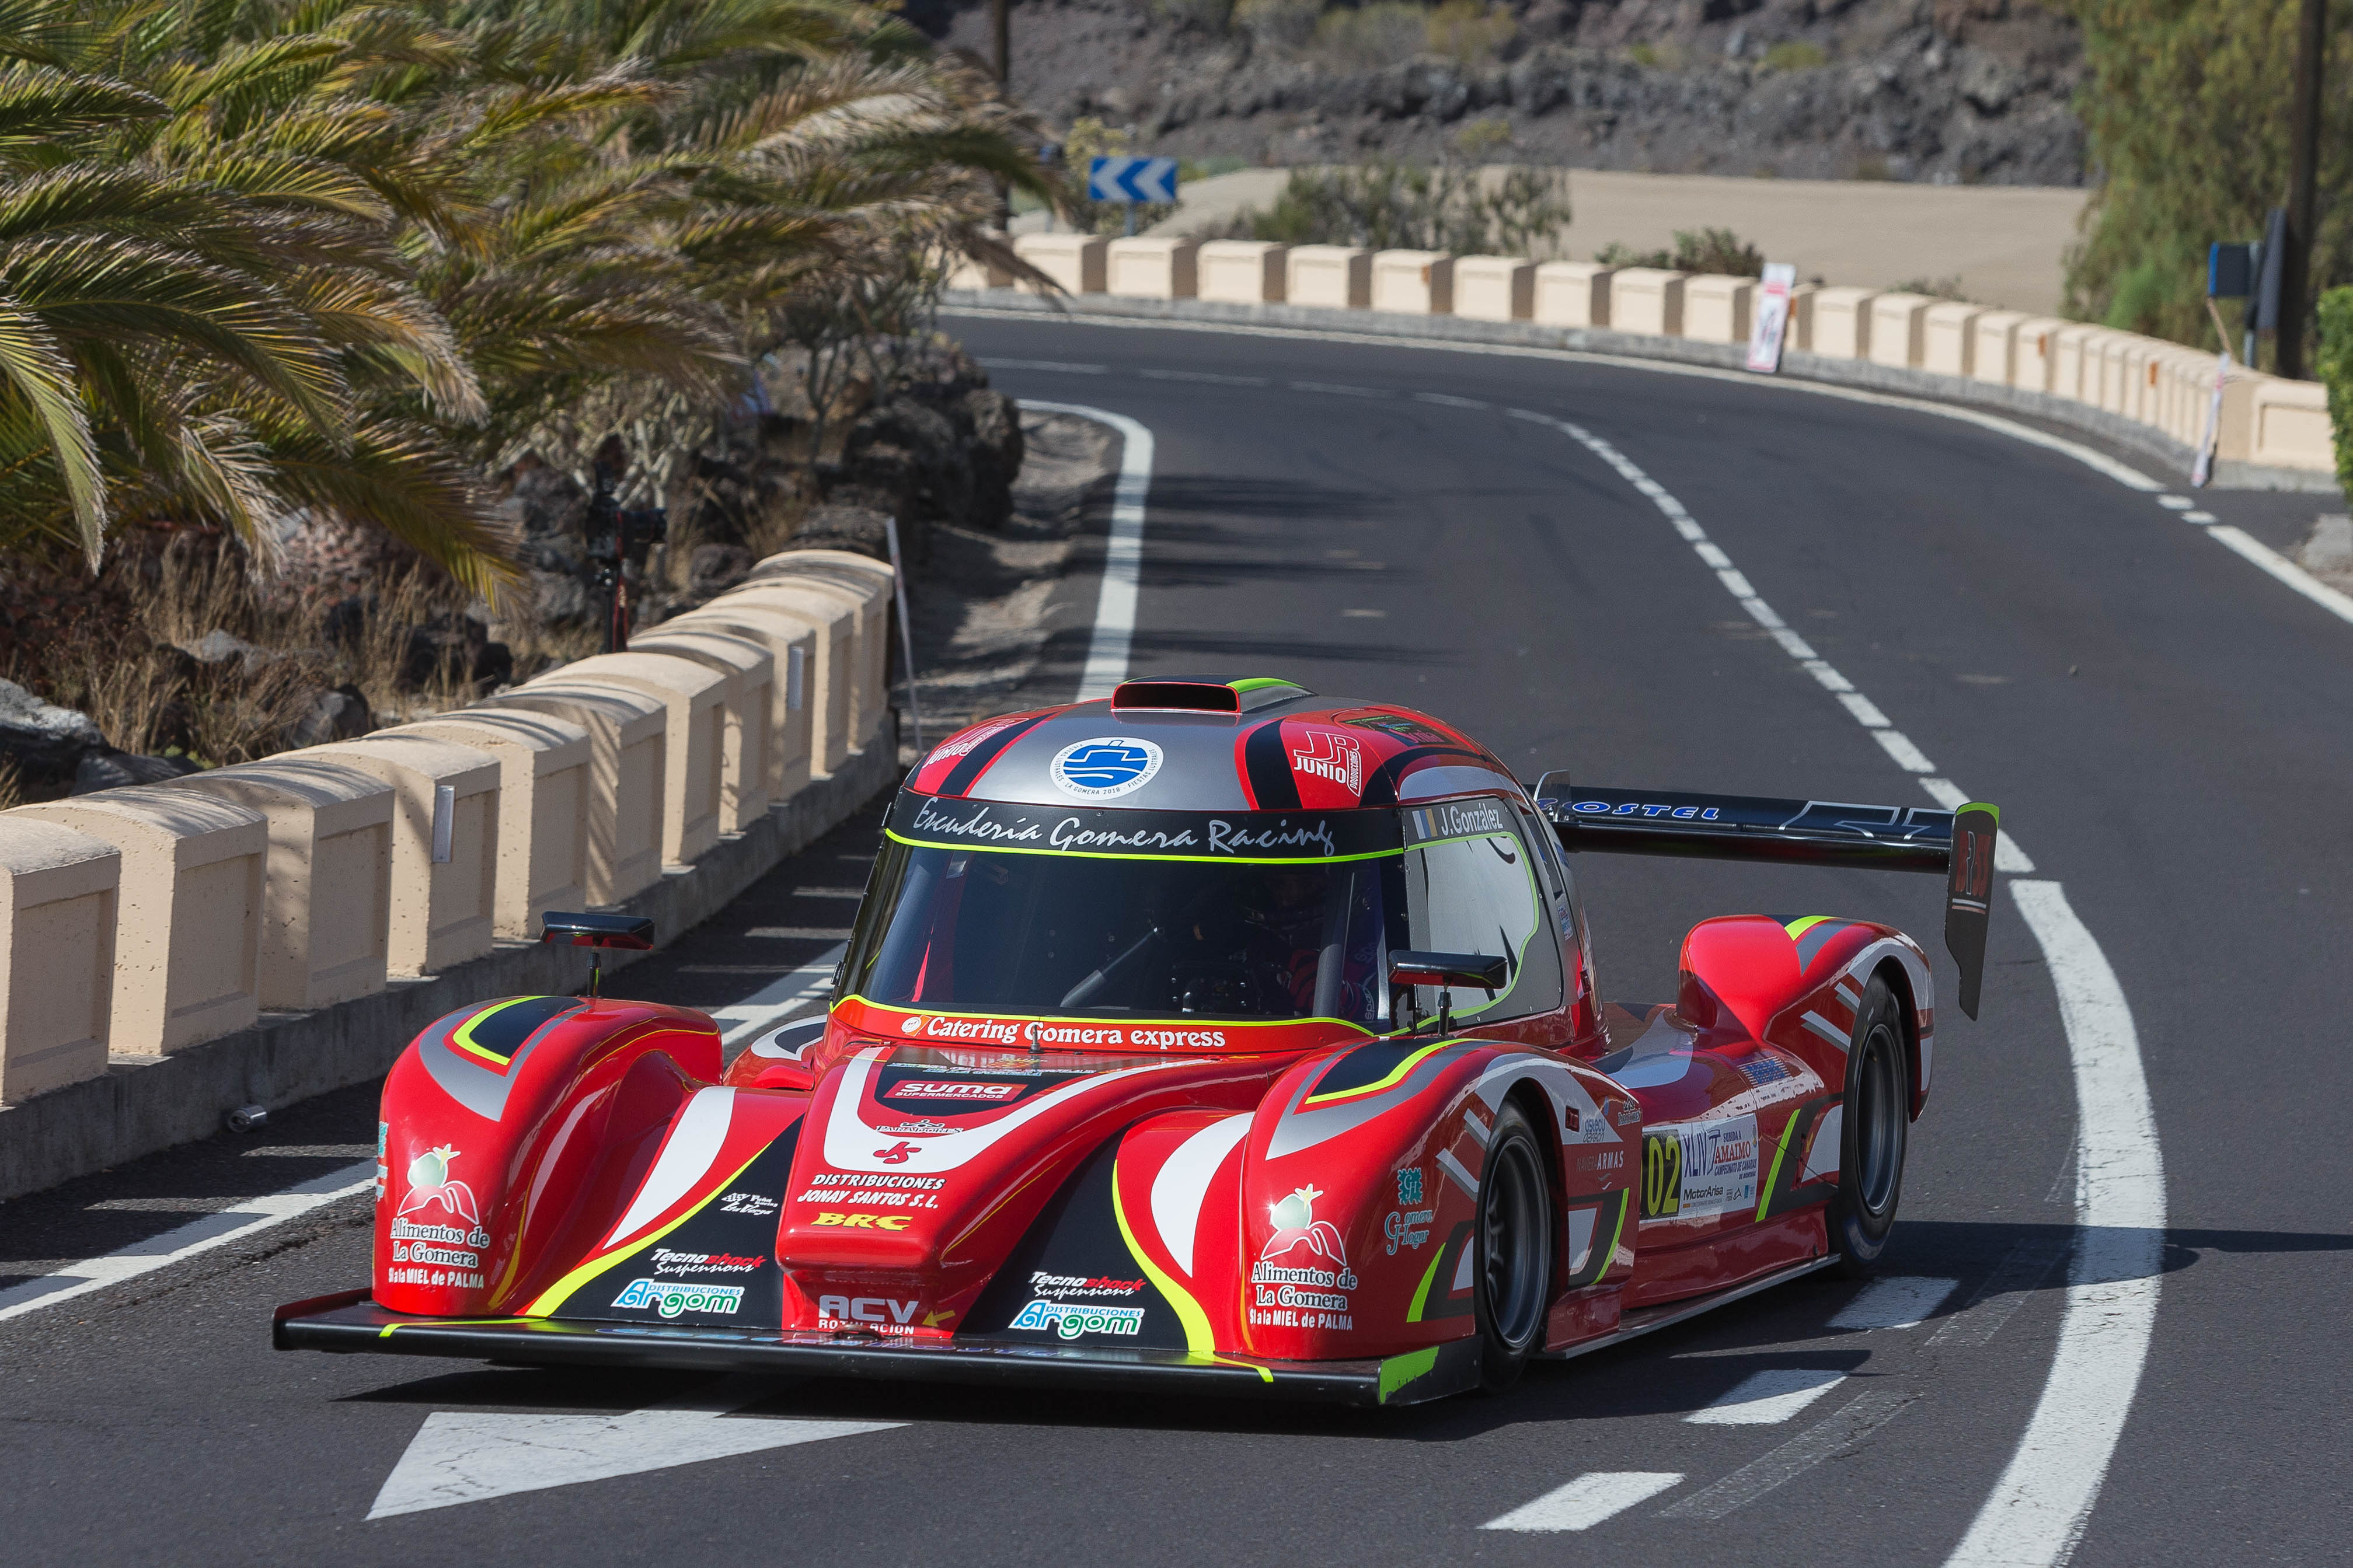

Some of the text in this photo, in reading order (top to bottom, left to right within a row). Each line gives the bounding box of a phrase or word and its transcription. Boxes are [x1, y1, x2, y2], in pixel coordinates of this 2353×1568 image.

[1294, 757, 1347, 784] JUNIO
[1073, 786, 1100, 795] GOMERA
[1127, 771, 1152, 789] FIESTAS
[913, 797, 1335, 857] Escudería Gomera Racing
[1440, 802, 1504, 837] J.González
[927, 1016, 1021, 1045] Catering
[1023, 1021, 1124, 1045] Gomera
[1130, 1028, 1226, 1050] express
[876, 1126, 964, 1134] PARADORES
[1596, 1150, 1624, 1171] ARMAS
[1681, 1130, 1708, 1178] XLIV
[811, 1174, 946, 1190] DISTRIBUCIONES
[1647, 1135, 1681, 1217] 02
[796, 1189, 850, 1203] JONAY
[848, 1190, 911, 1207] SANTOS
[1683, 1184, 1724, 1201] MotorArisa
[390, 1218, 489, 1247] Alimentos de
[810, 1211, 914, 1231] BRC
[394, 1242, 477, 1266] La Gomera
[431, 1270, 445, 1286] de
[447, 1271, 484, 1289] PALMA
[654, 1261, 755, 1277] Suspensions
[1253, 1262, 1357, 1288] Alimentos de
[649, 1284, 742, 1296] DISTRIBUCIONES
[1034, 1283, 1135, 1301] Suspensions
[1257, 1286, 1347, 1310] La Gomera
[818, 1294, 919, 1324] ACV
[1045, 1305, 1142, 1317] DISTRIBUCIONES
[1273, 1309, 1299, 1328] MIEL
[1301, 1312, 1316, 1328] de
[1317, 1313, 1354, 1332] PALMA
